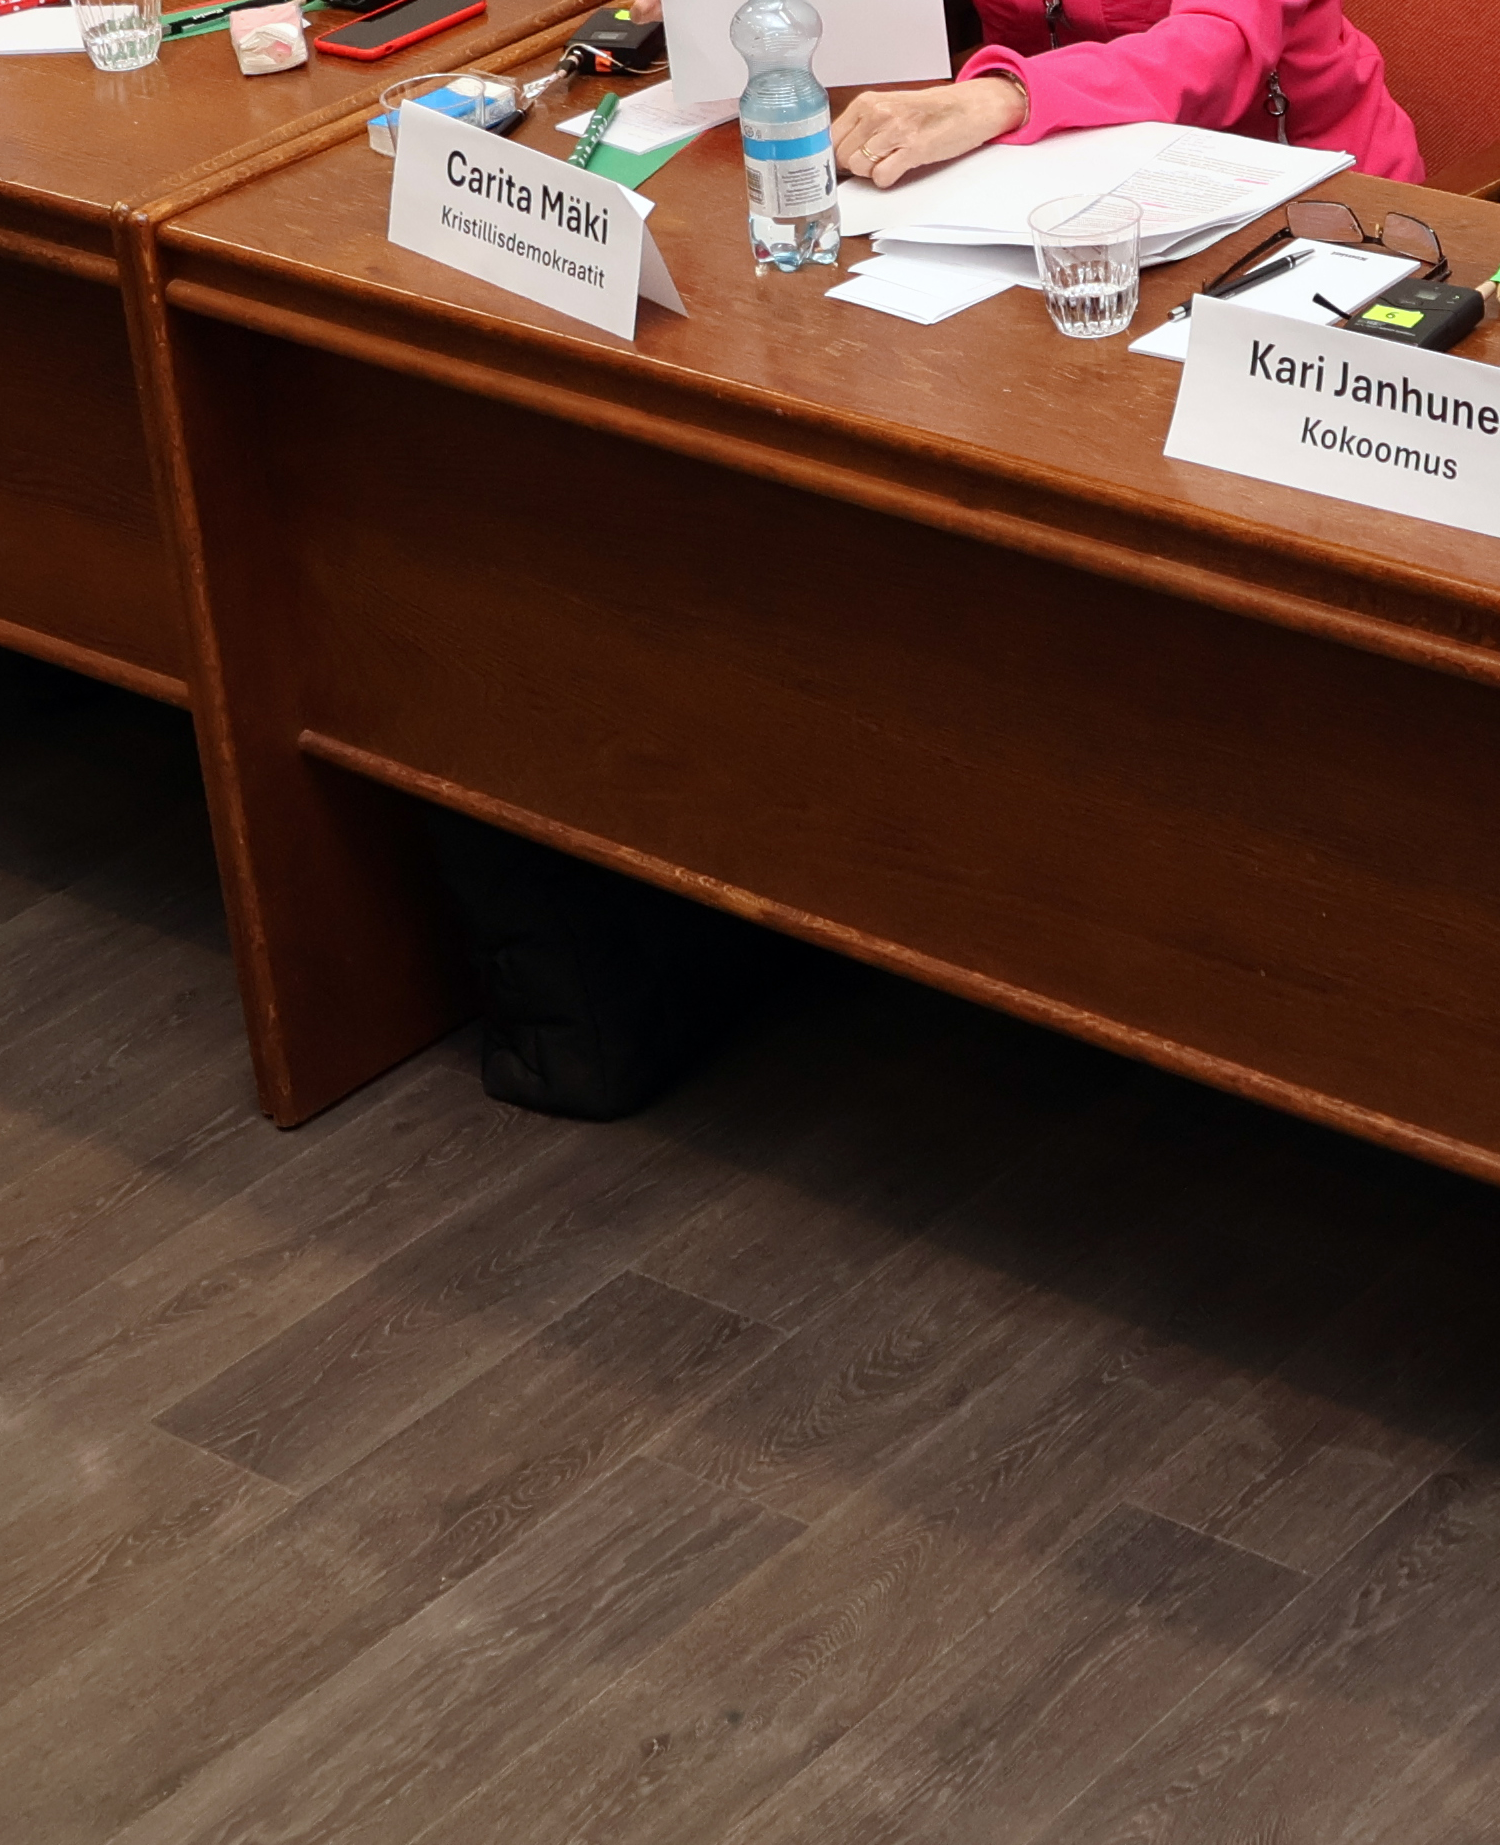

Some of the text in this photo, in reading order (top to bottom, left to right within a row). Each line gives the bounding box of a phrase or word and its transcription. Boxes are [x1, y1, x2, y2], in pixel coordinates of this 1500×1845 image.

[446, 149, 609, 246] Carita Mäki
[441, 204, 606, 290] Kristillisdemokraatit
[1249, 339, 1326, 393] Kari
[1300, 416, 1458, 481] Kokoomus
